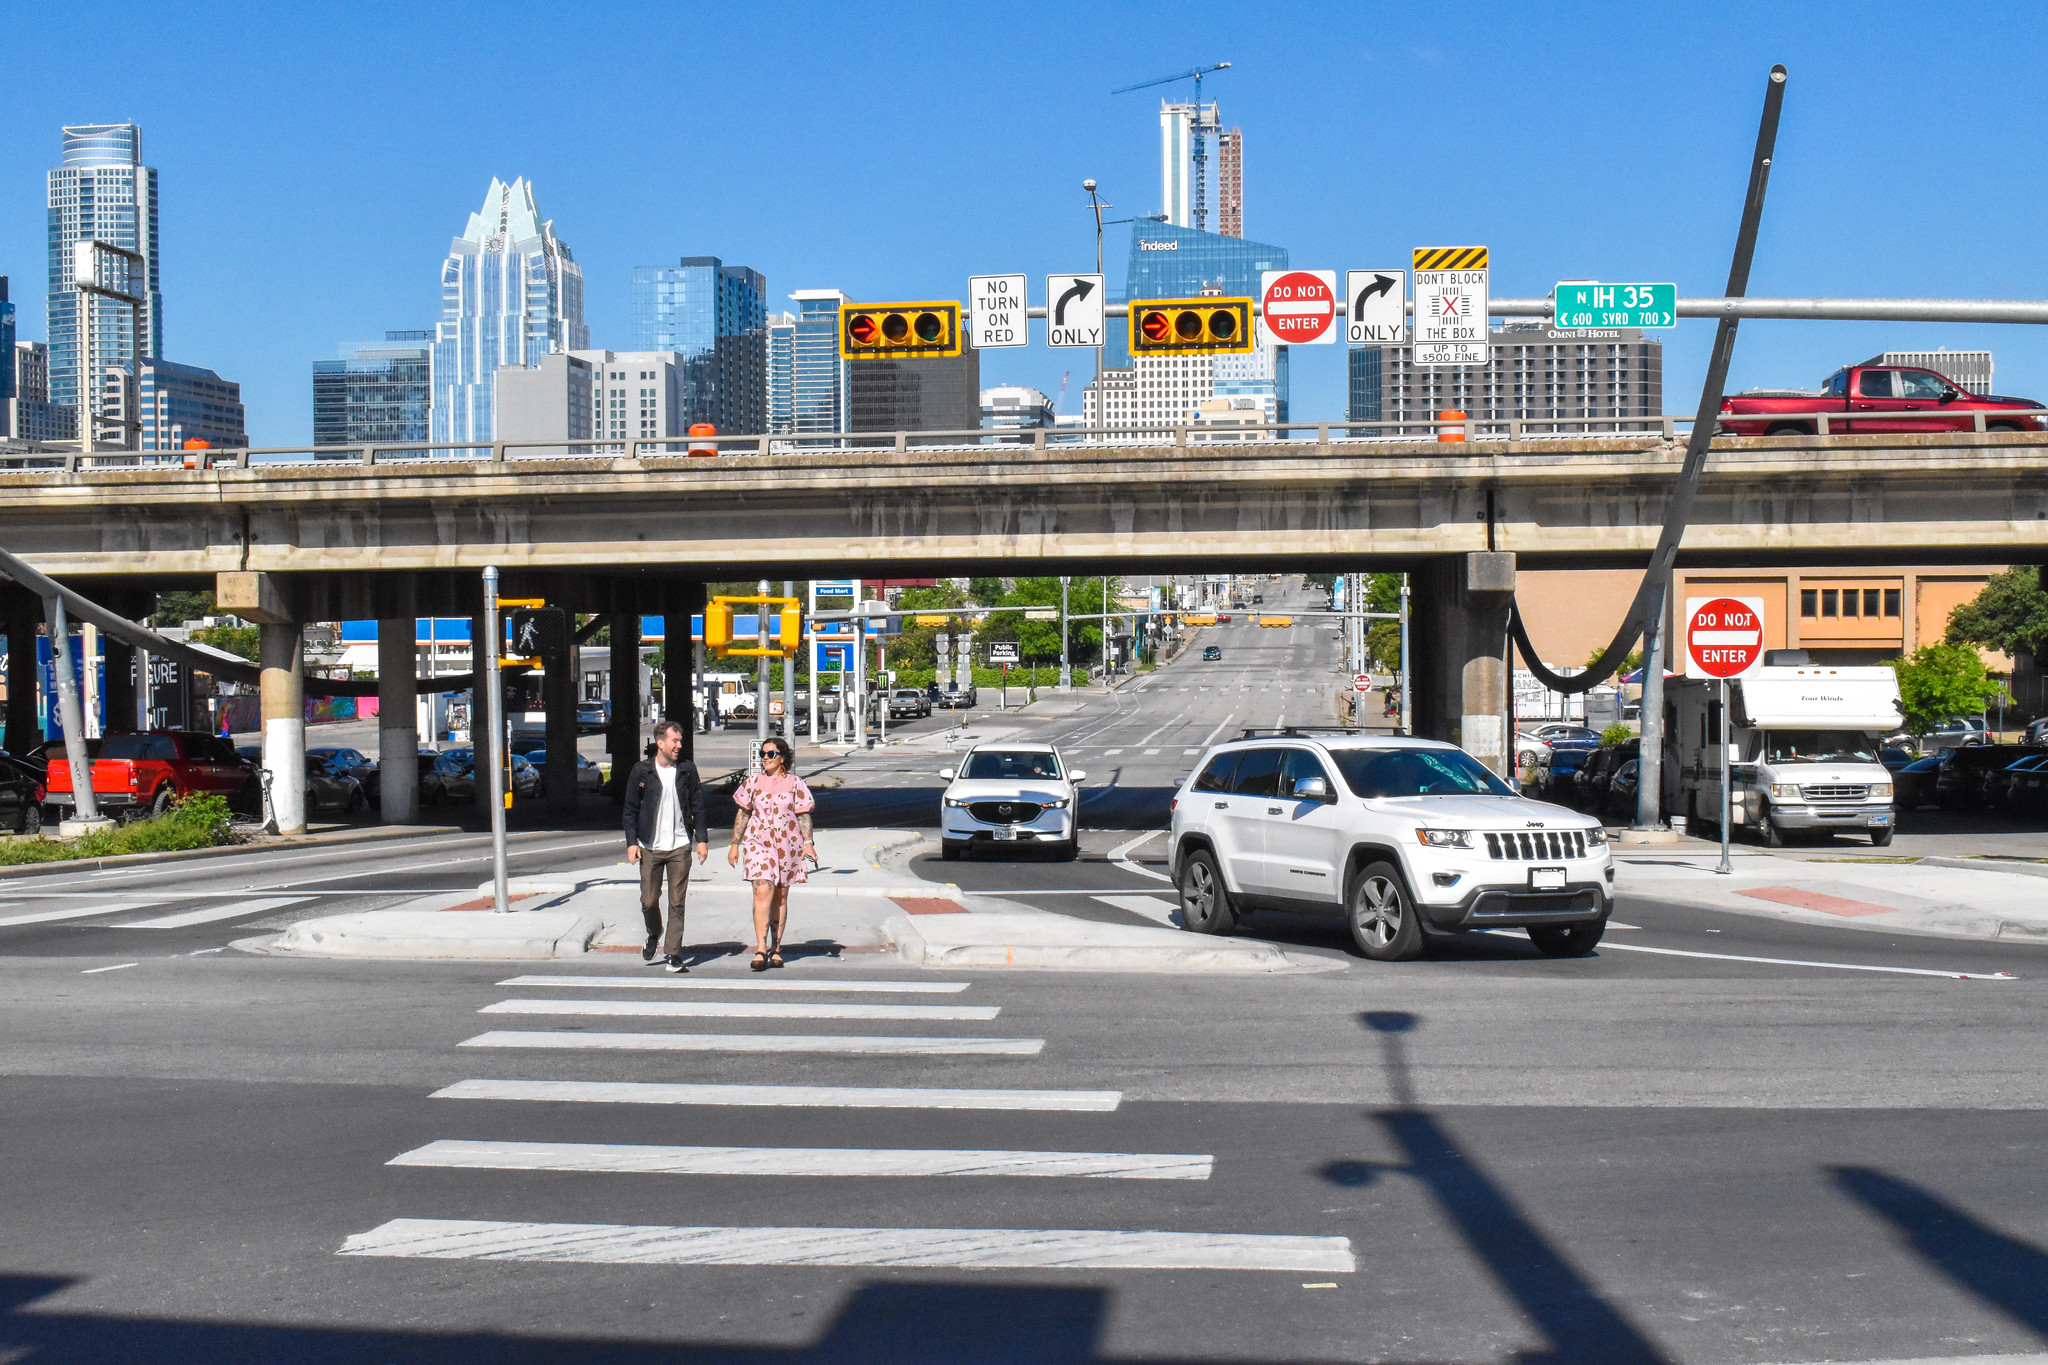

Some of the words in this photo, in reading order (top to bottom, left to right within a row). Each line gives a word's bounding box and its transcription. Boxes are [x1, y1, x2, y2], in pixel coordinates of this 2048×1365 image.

[1138, 239, 1178, 251] indeed
[1417, 273, 1445, 285] DON'T
[1450, 272, 1484, 285] BLOCK
[987, 280, 1008, 294] NO
[1273, 286, 1292, 298] DO
[1297, 285, 1324, 298] NOT
[978, 296, 1019, 311] TURN
[1593, 286, 1615, 308] IH
[1622, 286, 1654, 308] 35
[988, 313, 1009, 326] ON
[1278, 318, 1319, 330] ENTER
[1572, 312, 1592, 325] 600
[1602, 312, 1629, 325] SVRD
[1638, 312, 1659, 325] 700
[984, 329, 1014, 343] RED
[1051, 328, 1100, 344] ONLY
[1350, 324, 1400, 341] ONLY
[1426, 327, 1447, 339] THE
[1453, 327, 1475, 339] BOX
[1547, 329, 1575, 339] OMNI
[1587, 329, 1620, 338] HOTEL
[1433, 344, 1449, 353] UP
[1454, 344, 1468, 353] TO
[1422, 353, 1451, 362] $500
[1454, 352, 1479, 361] FINE
[1698, 613, 1717, 627] DO
[1724, 613, 1752, 627] NOT
[1702, 649, 1747, 663] ENTER
[1526, 820, 1545, 828] Jeep
